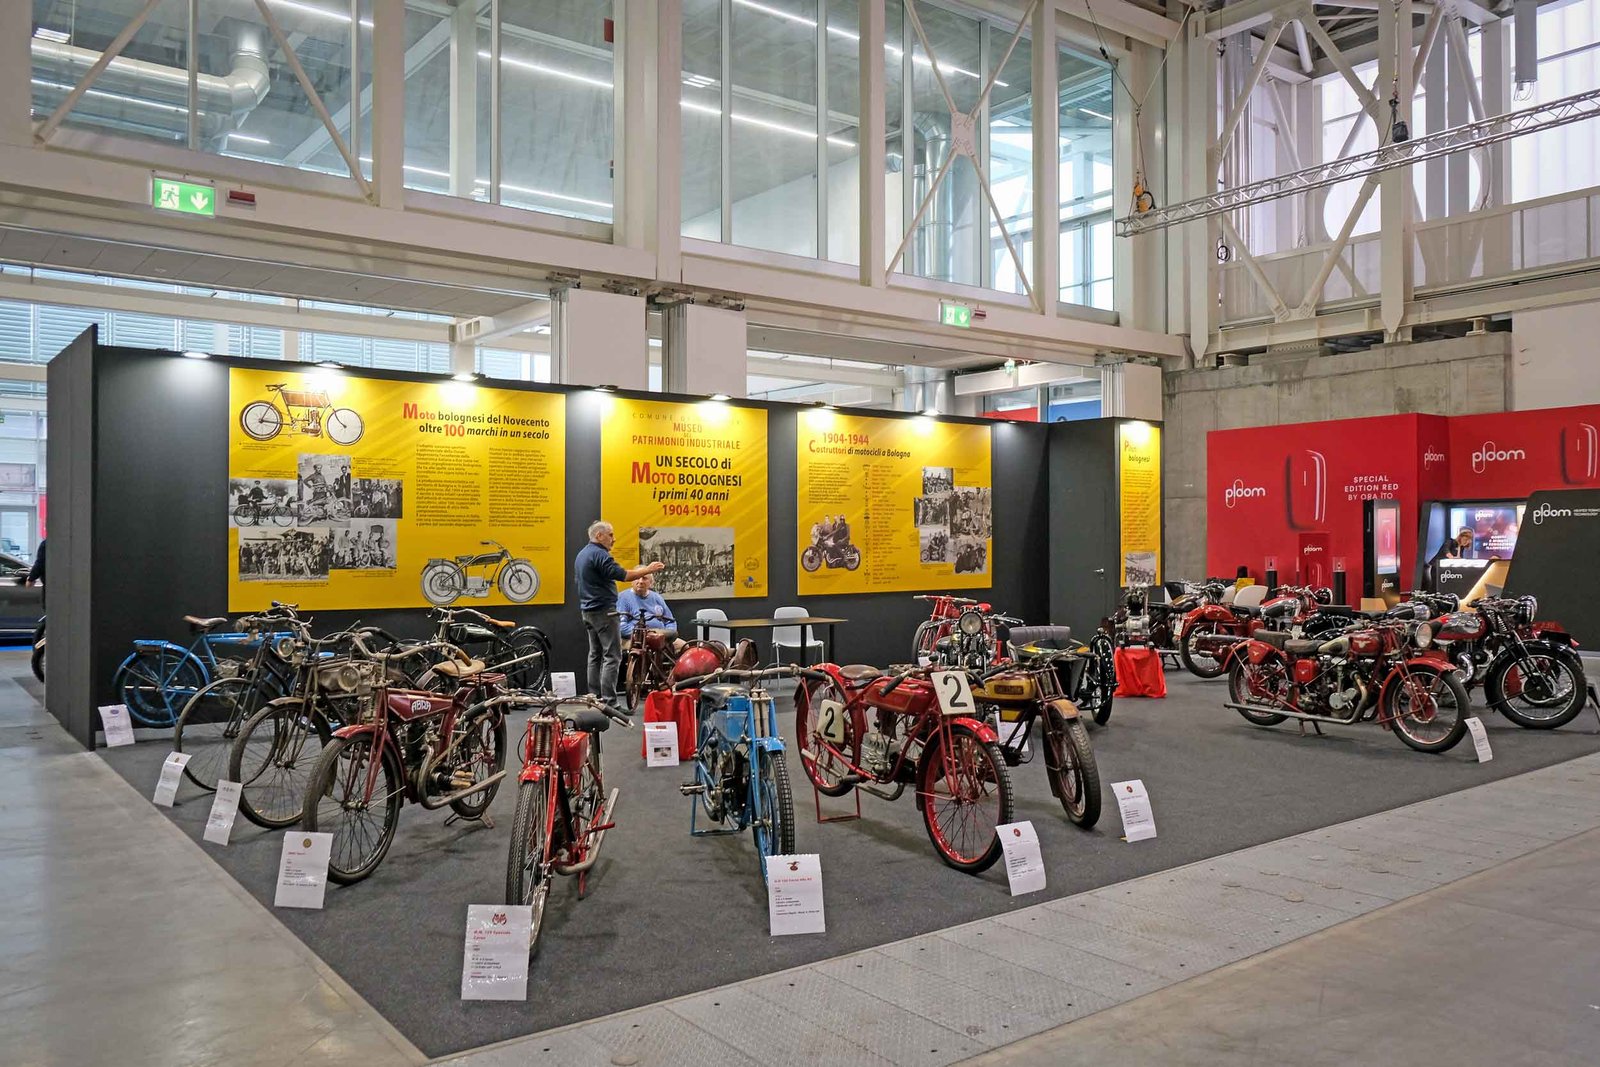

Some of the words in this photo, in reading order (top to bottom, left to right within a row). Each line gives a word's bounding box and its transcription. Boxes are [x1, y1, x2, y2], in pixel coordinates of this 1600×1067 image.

[403, 402, 436, 420] Moto
[438, 411, 485, 424] bolognesi
[487, 415, 501, 424] del
[503, 415, 550, 428] Novecento
[419, 423, 442, 434] oltre
[443, 424, 465, 437] 100
[466, 427, 498, 437] marchi
[500, 428, 508, 437] in
[522, 430, 550, 440] secolo
[673, 422, 703, 433] MUSEO
[632, 435, 685, 447] PATRIMONIO
[686, 438, 741, 450] INDUSTRIALE
[823, 432, 870, 446] 1904-1944
[809, 439, 847, 455] Costruttori
[847, 447, 854, 455] di
[854, 448, 881, 457] motocicli
[886, 449, 911, 459] Bologna
[655, 455, 673, 467] UN
[675, 456, 719, 469] SECOLO
[721, 458, 731, 469] di
[1128, 454, 1151, 465] bolognesi
[1424, 444, 1445, 470] ploom
[1472, 441, 1526, 474] ploom
[631, 461, 675, 484] MOTO
[678, 473, 742, 487] BOLOGNESI
[1353, 475, 1389, 484] SPECIAL
[652, 487, 657, 499] i
[658, 487, 688, 502] primi
[690, 489, 703, 500] 40
[705, 489, 730, 501] anni
[1225, 478, 1266, 508] ploom
[1344, 485, 1379, 493] EDITION
[1382, 483, 1399, 491] RED
[1348, 493, 1357, 501] BY
[1360, 493, 1378, 501] ORA
[662, 504, 721, 517] 1904-1944
[1533, 502, 1571, 525] ploom
[1440, 570, 1463, 583] ploom
[942, 674, 967, 708] 2
[824, 706, 836, 738] 2
